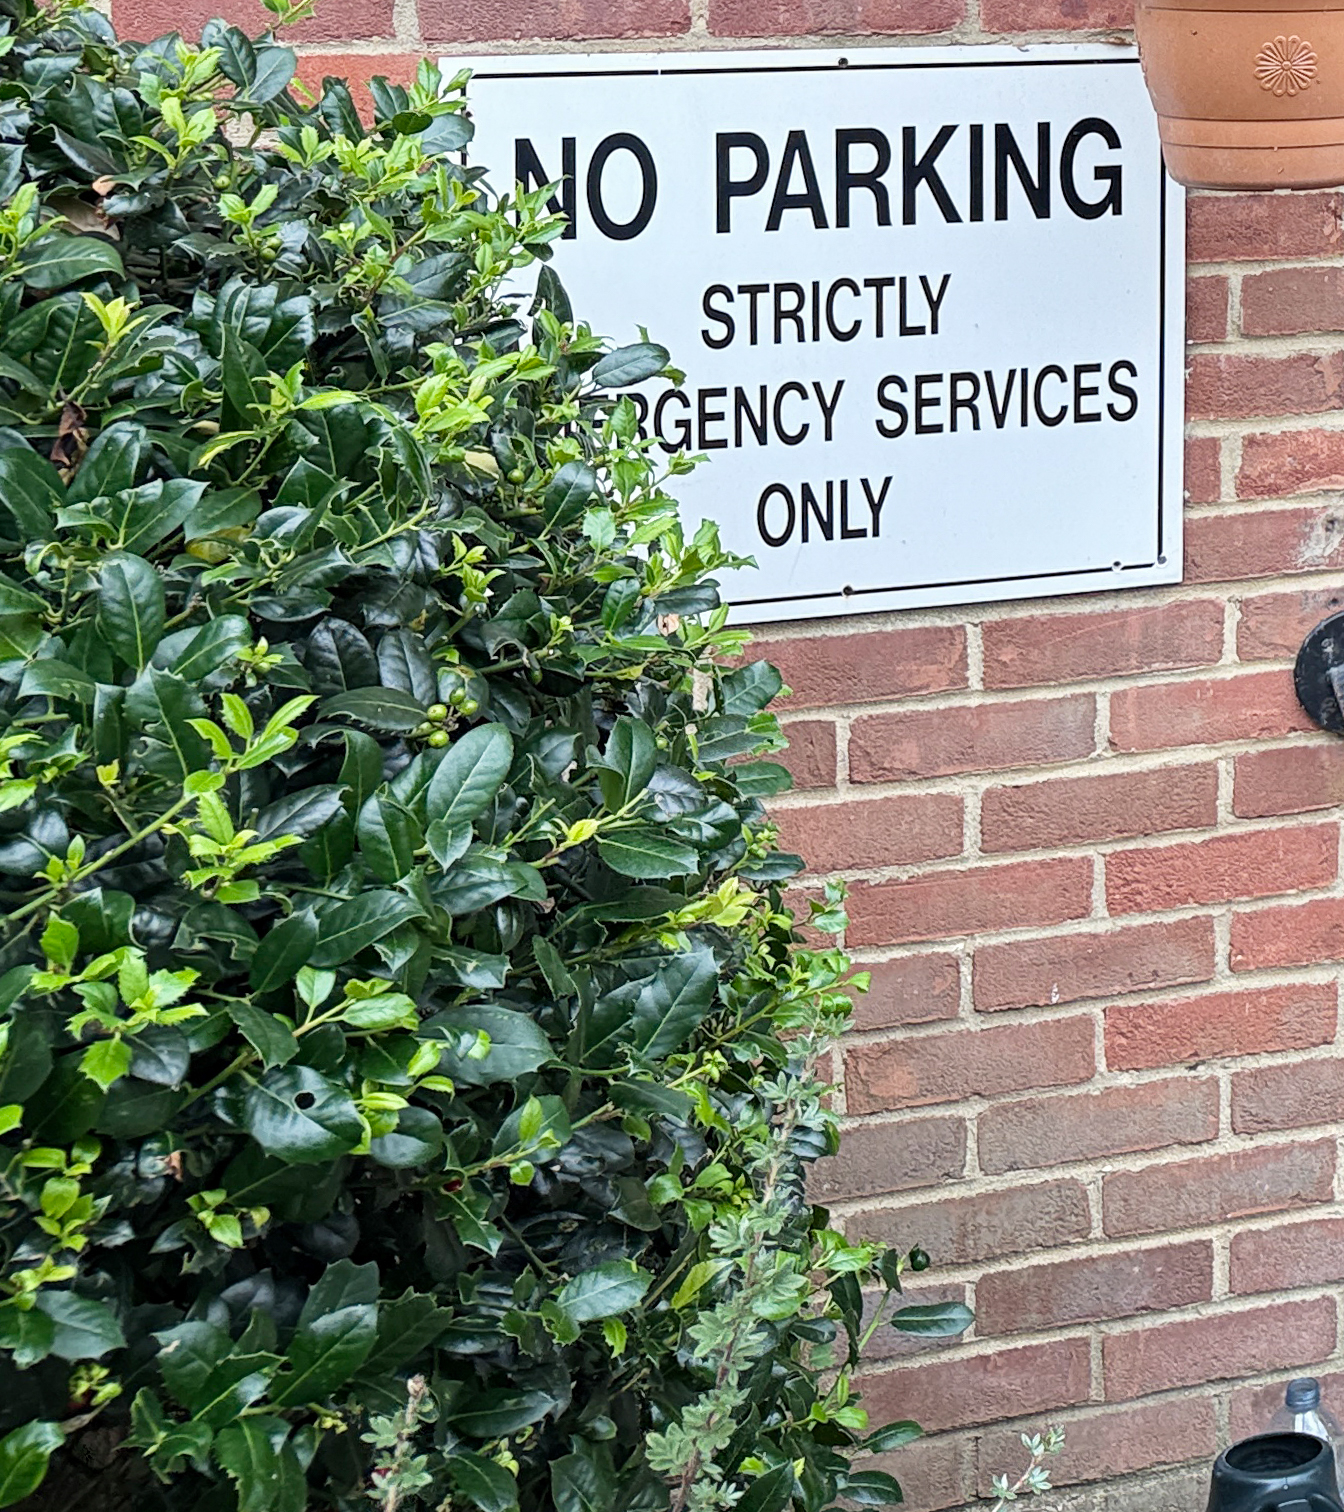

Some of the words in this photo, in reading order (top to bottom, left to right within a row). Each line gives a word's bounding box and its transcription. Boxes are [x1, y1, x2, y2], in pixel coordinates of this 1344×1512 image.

[513, 132, 658, 242] NO
[715, 116, 1124, 235] PARKING
[700, 272, 952, 351] STRICTLY
[875, 358, 1139, 440] SERVICES
[756, 474, 894, 549] ONLY
